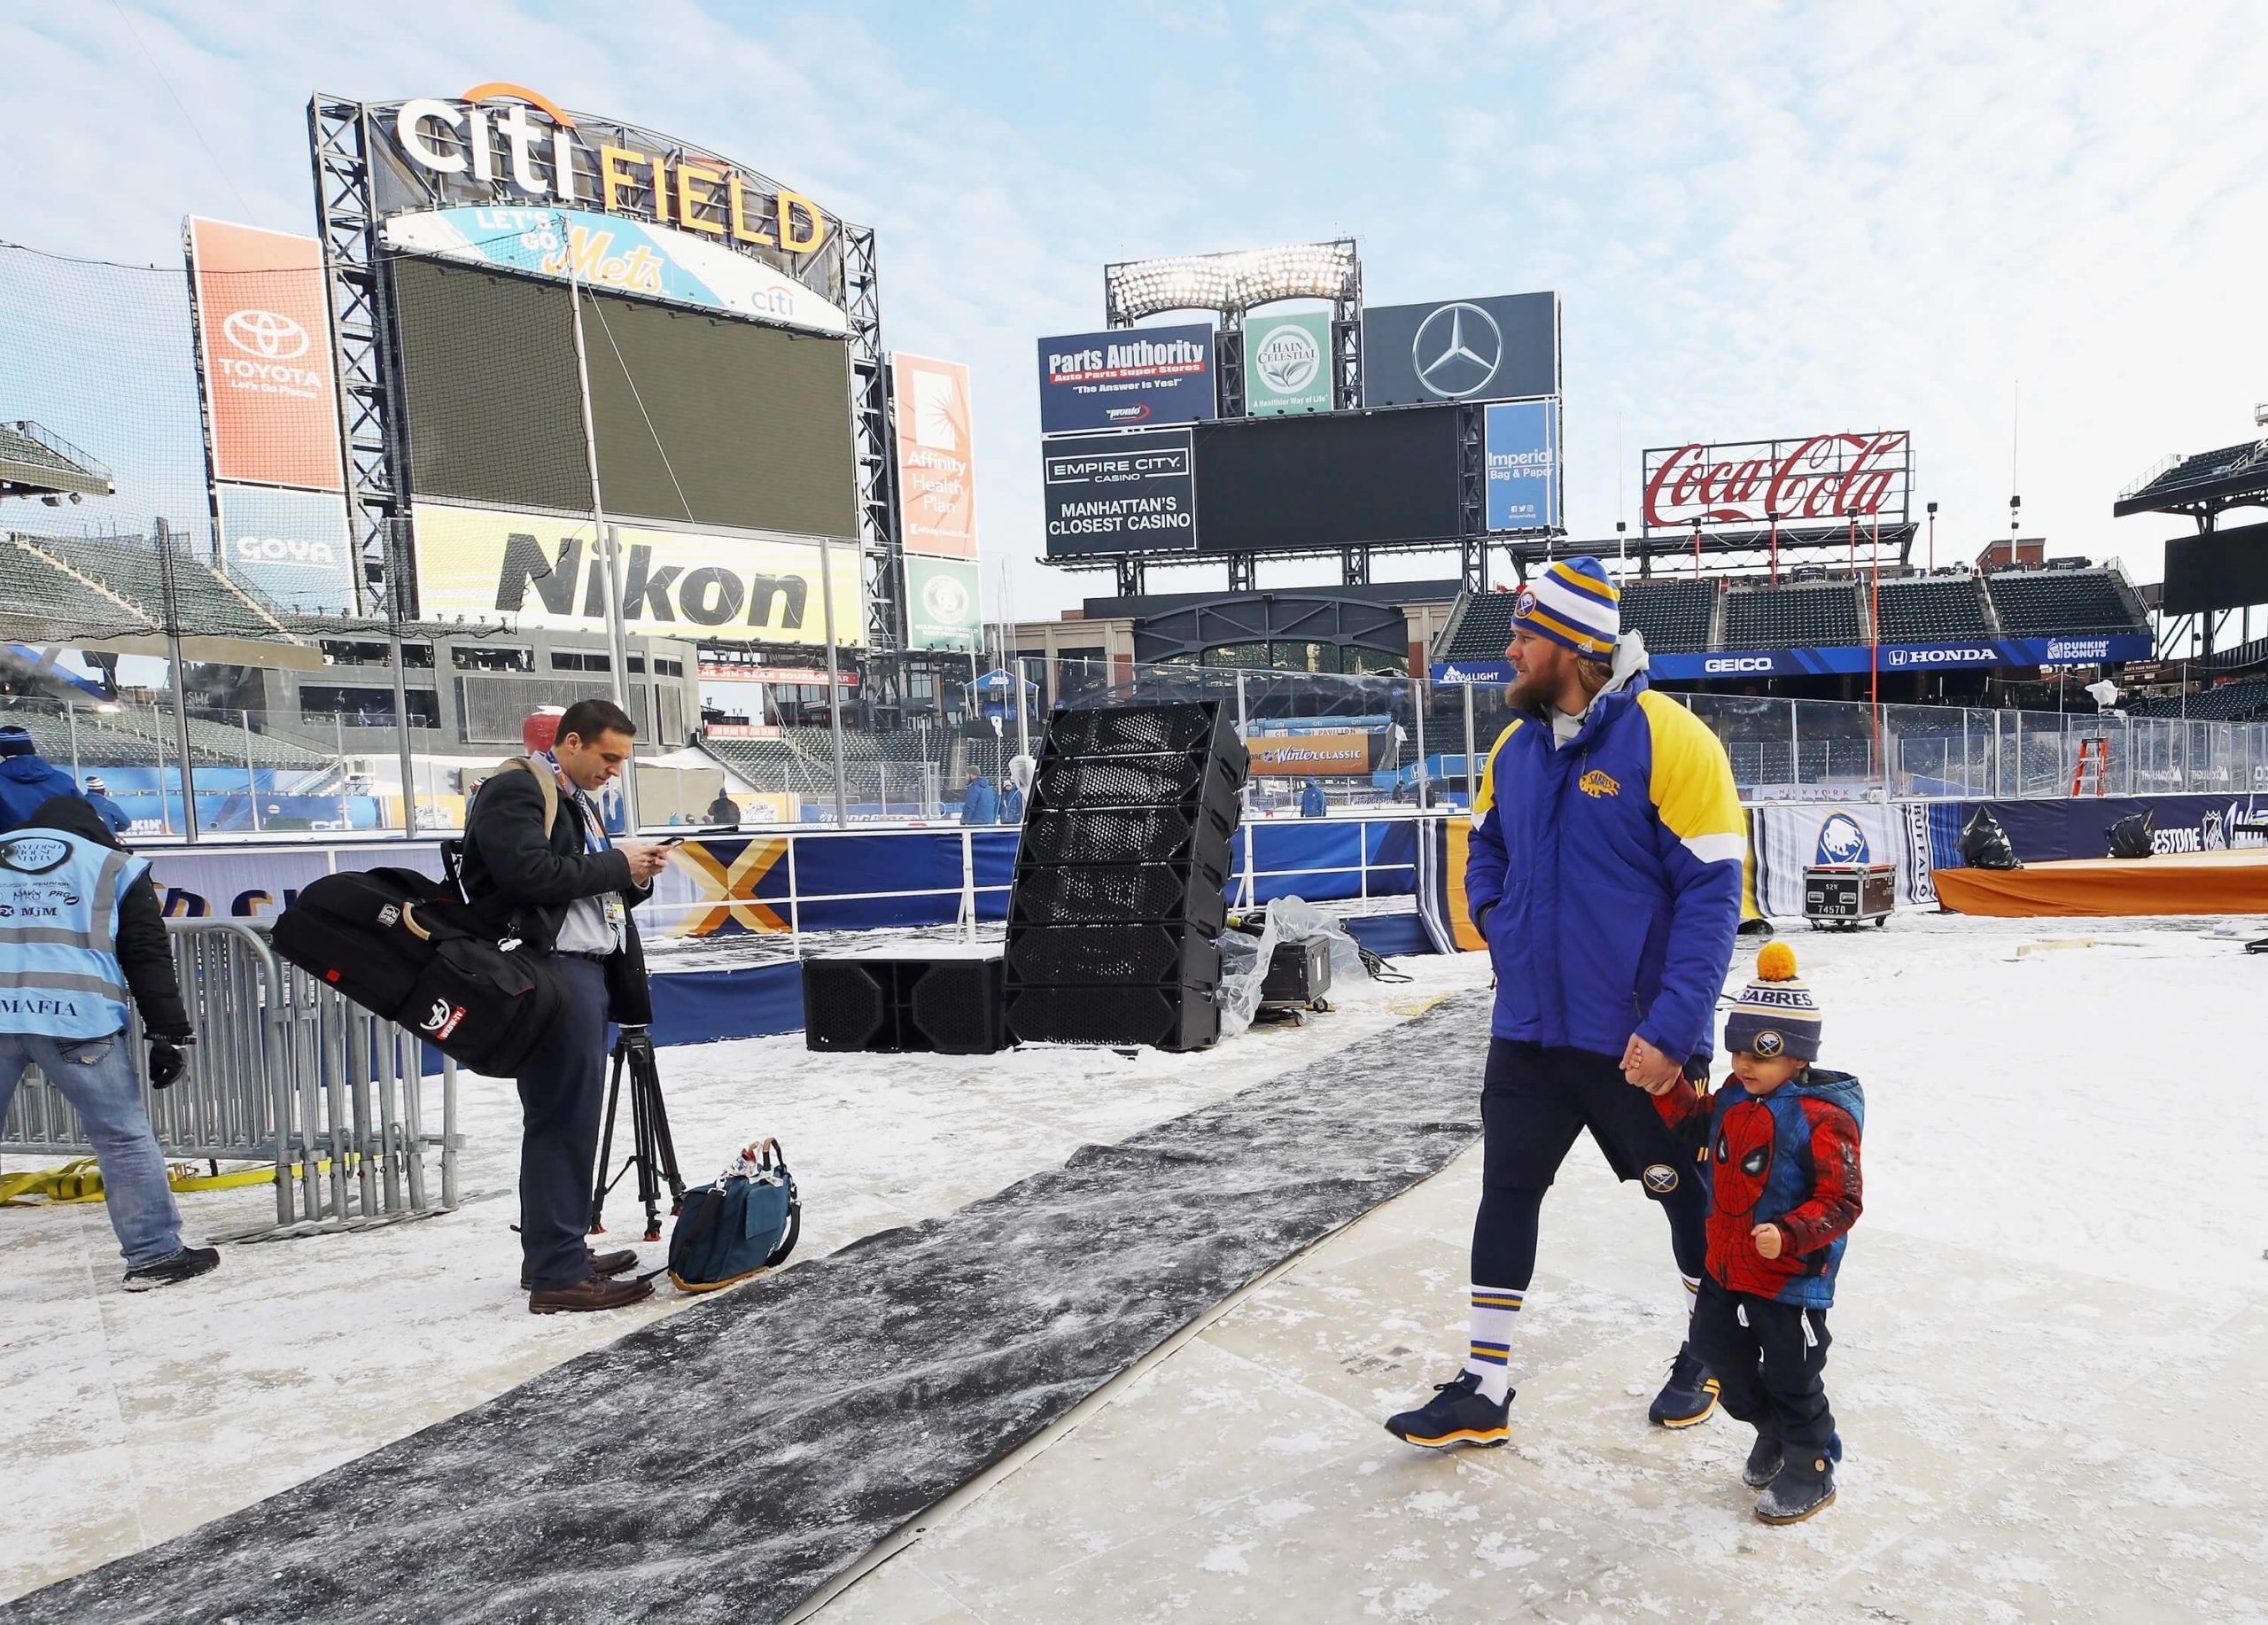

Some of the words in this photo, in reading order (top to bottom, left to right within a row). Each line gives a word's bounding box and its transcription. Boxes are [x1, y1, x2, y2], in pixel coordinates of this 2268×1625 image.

[398, 97, 575, 202] citi
[600, 144, 824, 253] FIELD
[475, 209, 550, 230] LET'S
[520, 230, 558, 251] GO
[542, 225, 664, 294] Mets
[750, 291, 794, 315] citi
[1049, 349, 1104, 375] Parts
[1107, 339, 1204, 369] Authority
[1257, 348, 1315, 364] CELESTIAL
[1272, 342, 1303, 353] HAIN
[218, 358, 322, 388] TOYOTA
[1085, 370, 1117, 379] Parts
[1120, 367, 1156, 377] Super
[1159, 363, 1201, 373] Stores
[1099, 382, 1139, 392] Answer
[1290, 396, 1304, 405] Way
[908, 451, 967, 477] Affinity
[1488, 448, 1553, 468] Imperial
[1053, 461, 1130, 476] EMPIRE
[1095, 473, 1141, 483] CASINO
[1490, 470, 1511, 481] Bag
[1513, 469, 1520, 478] &
[1524, 467, 1553, 478] Paper
[913, 473, 964, 495] Health
[923, 494, 956, 514] Plan
[1061, 496, 1177, 518] MANHATTAN'S
[1049, 517, 1123, 535] CLOSEST
[1128, 513, 1191, 531] CASINO
[236, 535, 334, 564] GOYA
[495, 533, 808, 629] Nikon
[1909, 649, 1998, 663] HONDA
[2063, 641, 2109, 651] DUNKIN'
[2063, 649, 2107, 658] DONUTS
[1705, 657, 1772, 673] GEICO
[1472, 672, 1499, 681] LIGHT
[1274, 745, 1319, 765] Winter
[1319, 750, 1362, 760] CLASSIC
[1589, 773, 1612, 789] SABRES
[2150, 828, 2202, 854] ESTONE
[1913, 805, 1928, 898] BUFFALO
[1818, 905, 1845, 914] 74570
[1739, 988, 1814, 1007] SABRES
[0, 999, 78, 1017] MAFIA
